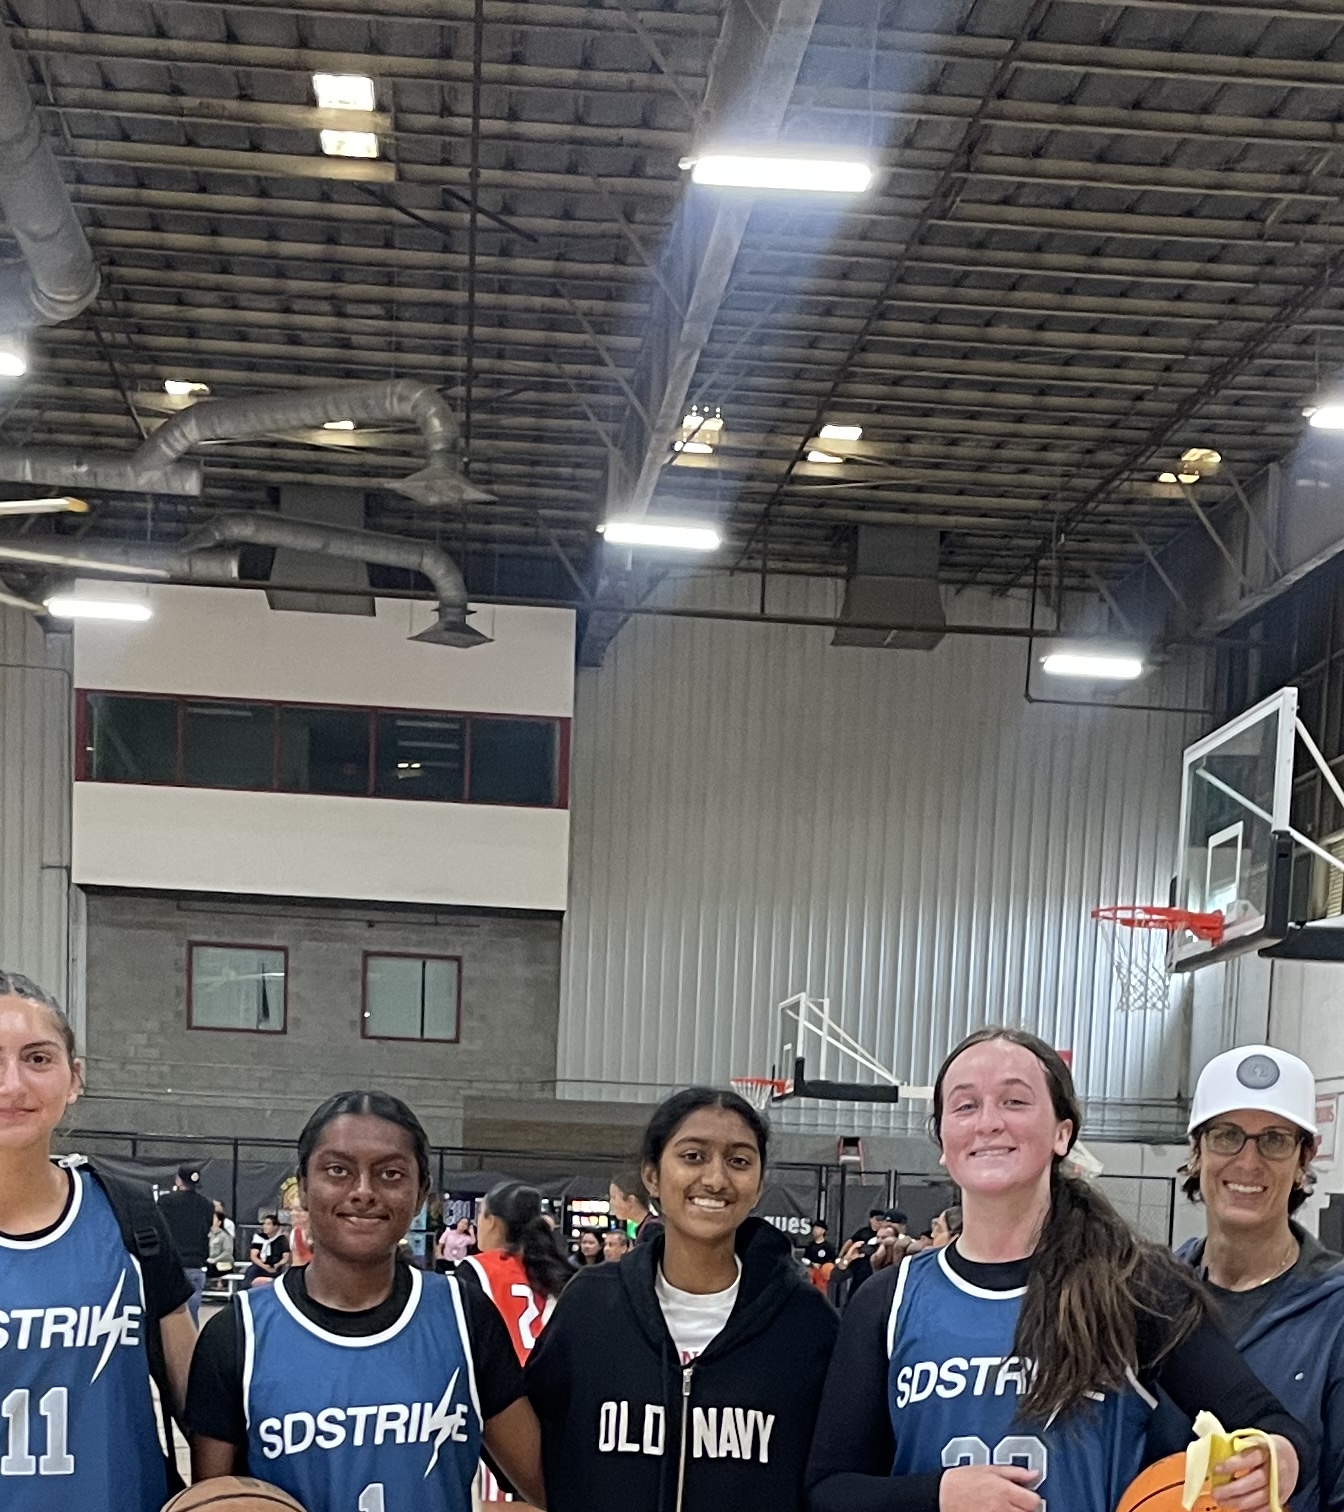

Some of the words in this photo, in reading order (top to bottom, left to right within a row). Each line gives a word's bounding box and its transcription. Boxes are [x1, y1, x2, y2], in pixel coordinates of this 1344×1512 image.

[1, 1387, 75, 1476] 11
[259, 1367, 469, 1480] SDSTRIKE
[599, 1400, 665, 1456] OLD
[692, 1406, 776, 1464] NAVY
